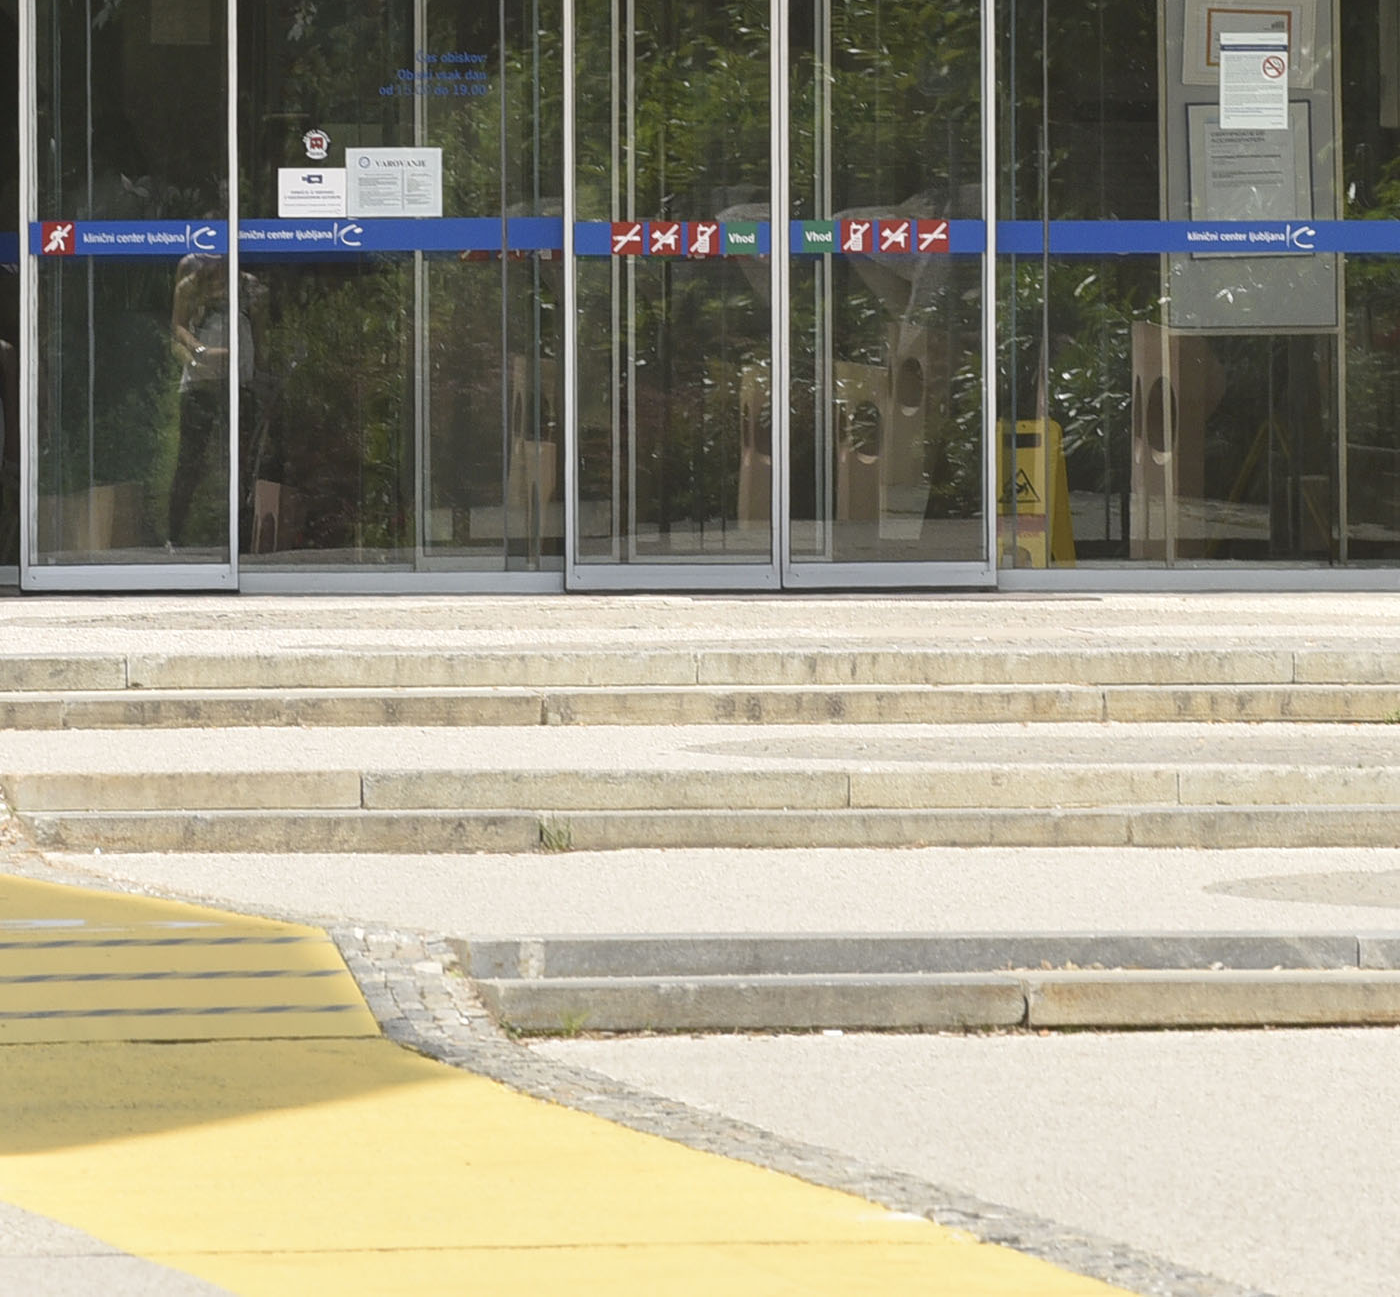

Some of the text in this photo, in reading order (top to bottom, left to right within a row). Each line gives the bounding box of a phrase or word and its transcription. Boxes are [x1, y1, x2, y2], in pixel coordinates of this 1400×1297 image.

[379, 85, 394, 95] od
[434, 84, 449, 95] do
[454, 84, 487, 95] 19.00
[374, 159, 427, 168] VAROVANJE
[83, 232, 185, 245] klinični center ljubljana
[266, 230, 294, 241] center
[295, 229, 333, 242] ljubljana
[728, 231, 755, 245] Vhod
[805, 230, 832, 243] Vhod
[1187, 231, 1285, 243] klinični center ljubljana
